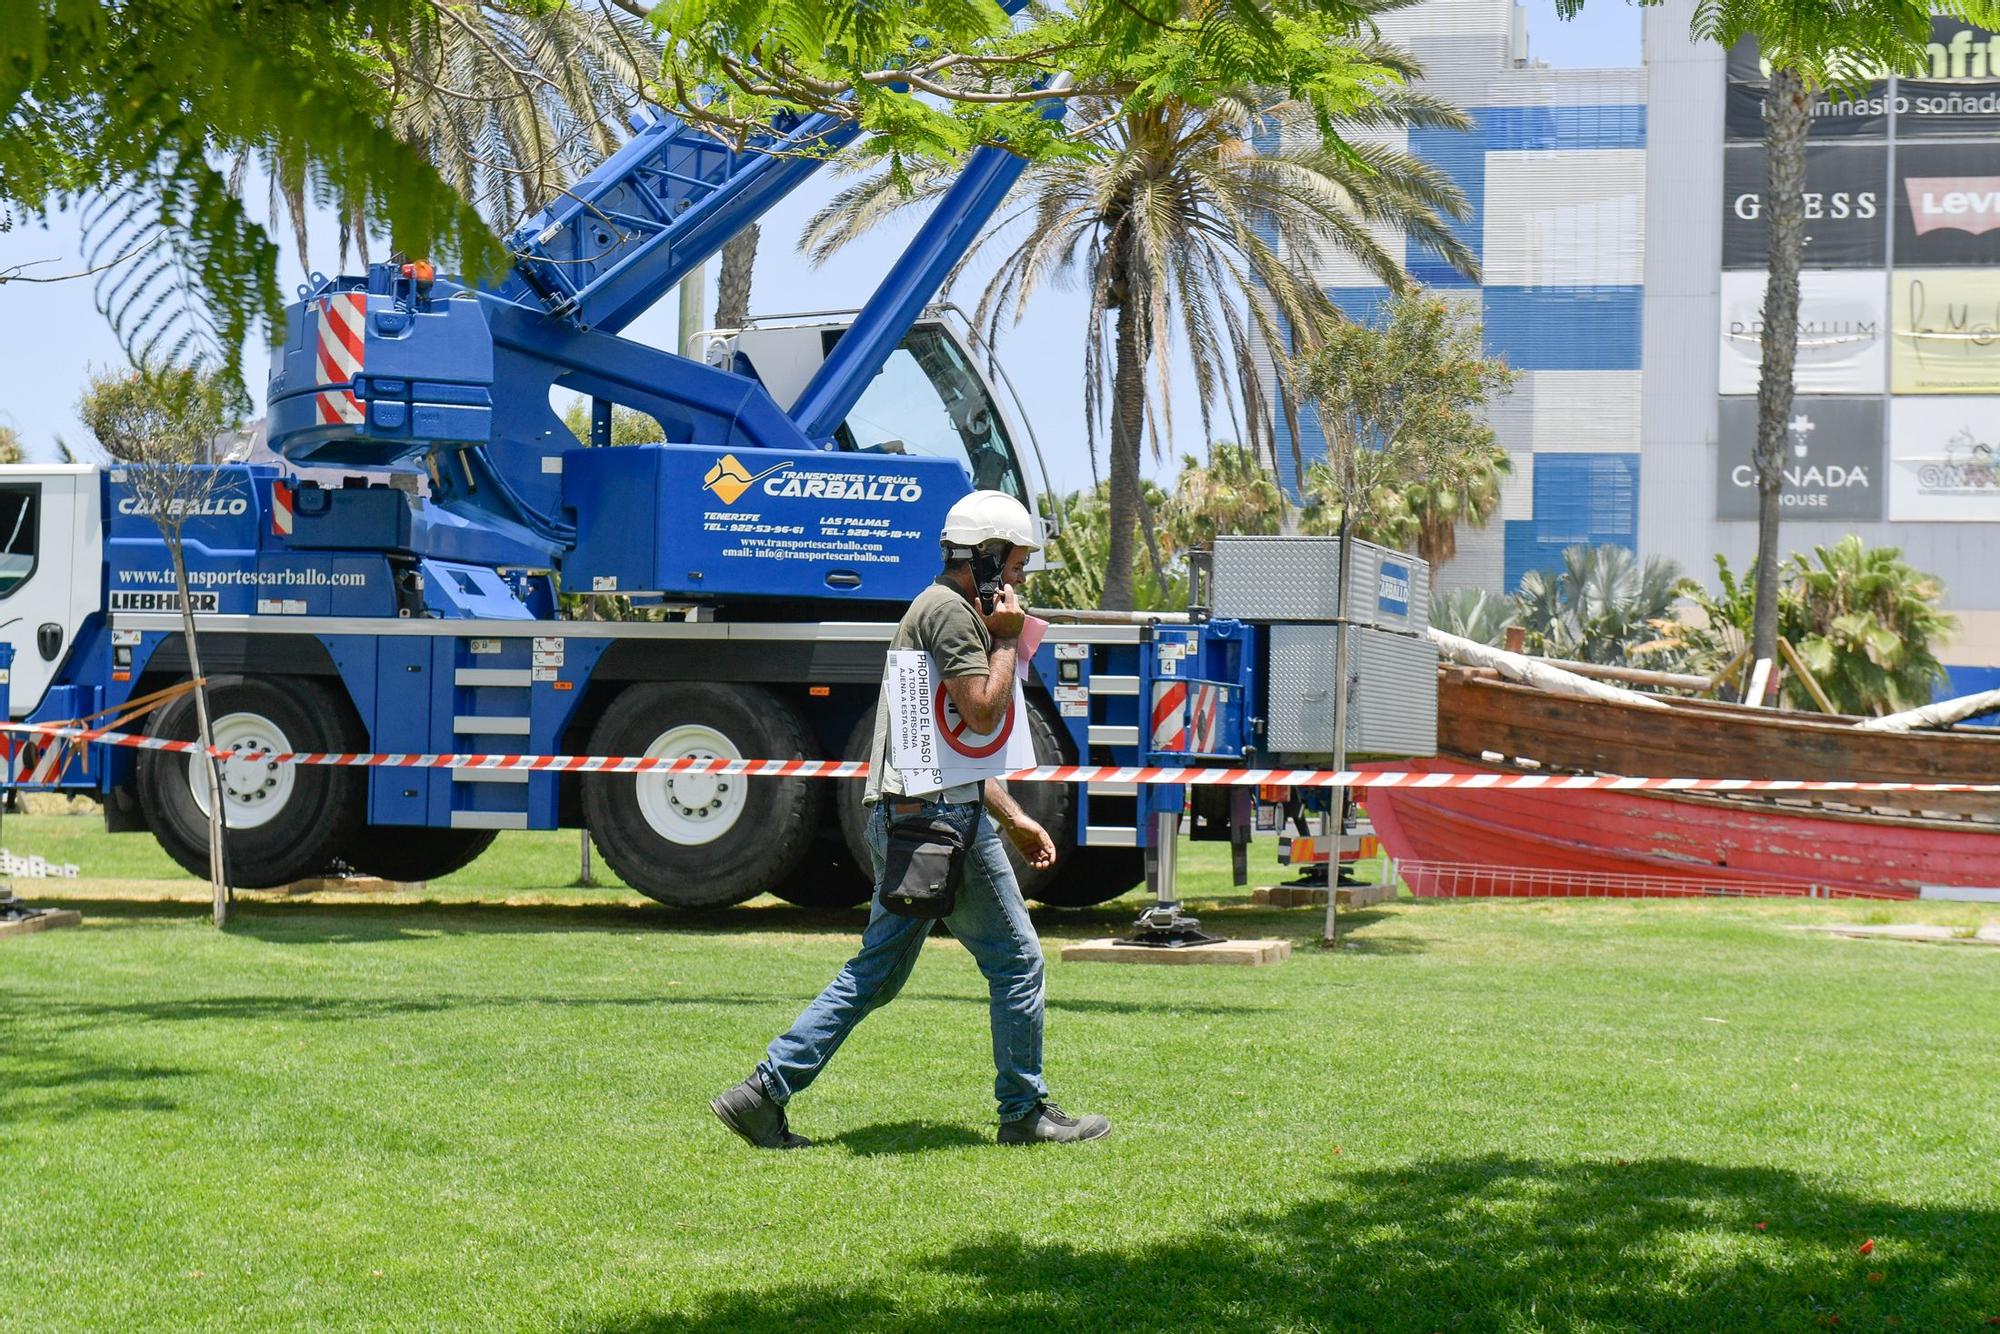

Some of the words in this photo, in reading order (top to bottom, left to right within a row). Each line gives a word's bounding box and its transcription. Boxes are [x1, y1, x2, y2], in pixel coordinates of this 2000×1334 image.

[1915, 91, 2000, 115] soñad
[1734, 192, 1876, 220] GESS
[1731, 321, 1876, 341] PRMIUM
[782, 471, 866, 482] TRANSPORTES
[878, 474, 918, 485] GRÚAS
[1731, 465, 1869, 487] CNADA
[763, 478, 922, 502] CARBALLO
[703, 512, 760, 521] TENERIFE
[819, 517, 842, 525] LAS
[843, 518, 891, 527] PALMAS
[703, 523, 729, 531] TEL.:
[729, 524, 804, 534] 922-53-96-61
[820, 528, 845, 536] TEL.:
[846, 529, 921, 539] 928-46-18-44
[722, 547, 753, 557] email:
[755, 548, 900, 562] info@transportescarballo.com
[740, 538, 883, 551] www.transportescarballo.com
[119, 568, 366, 588] www.trnsportescarballo.com
[1164, 661, 1172, 673] 4
[899, 668, 907, 694] AJENA
[917, 654, 929, 715] PROHIBIDO
[910, 704, 918, 748] PERSONA
[920, 718, 930, 731] EL
[921, 734, 931, 763] PASO
